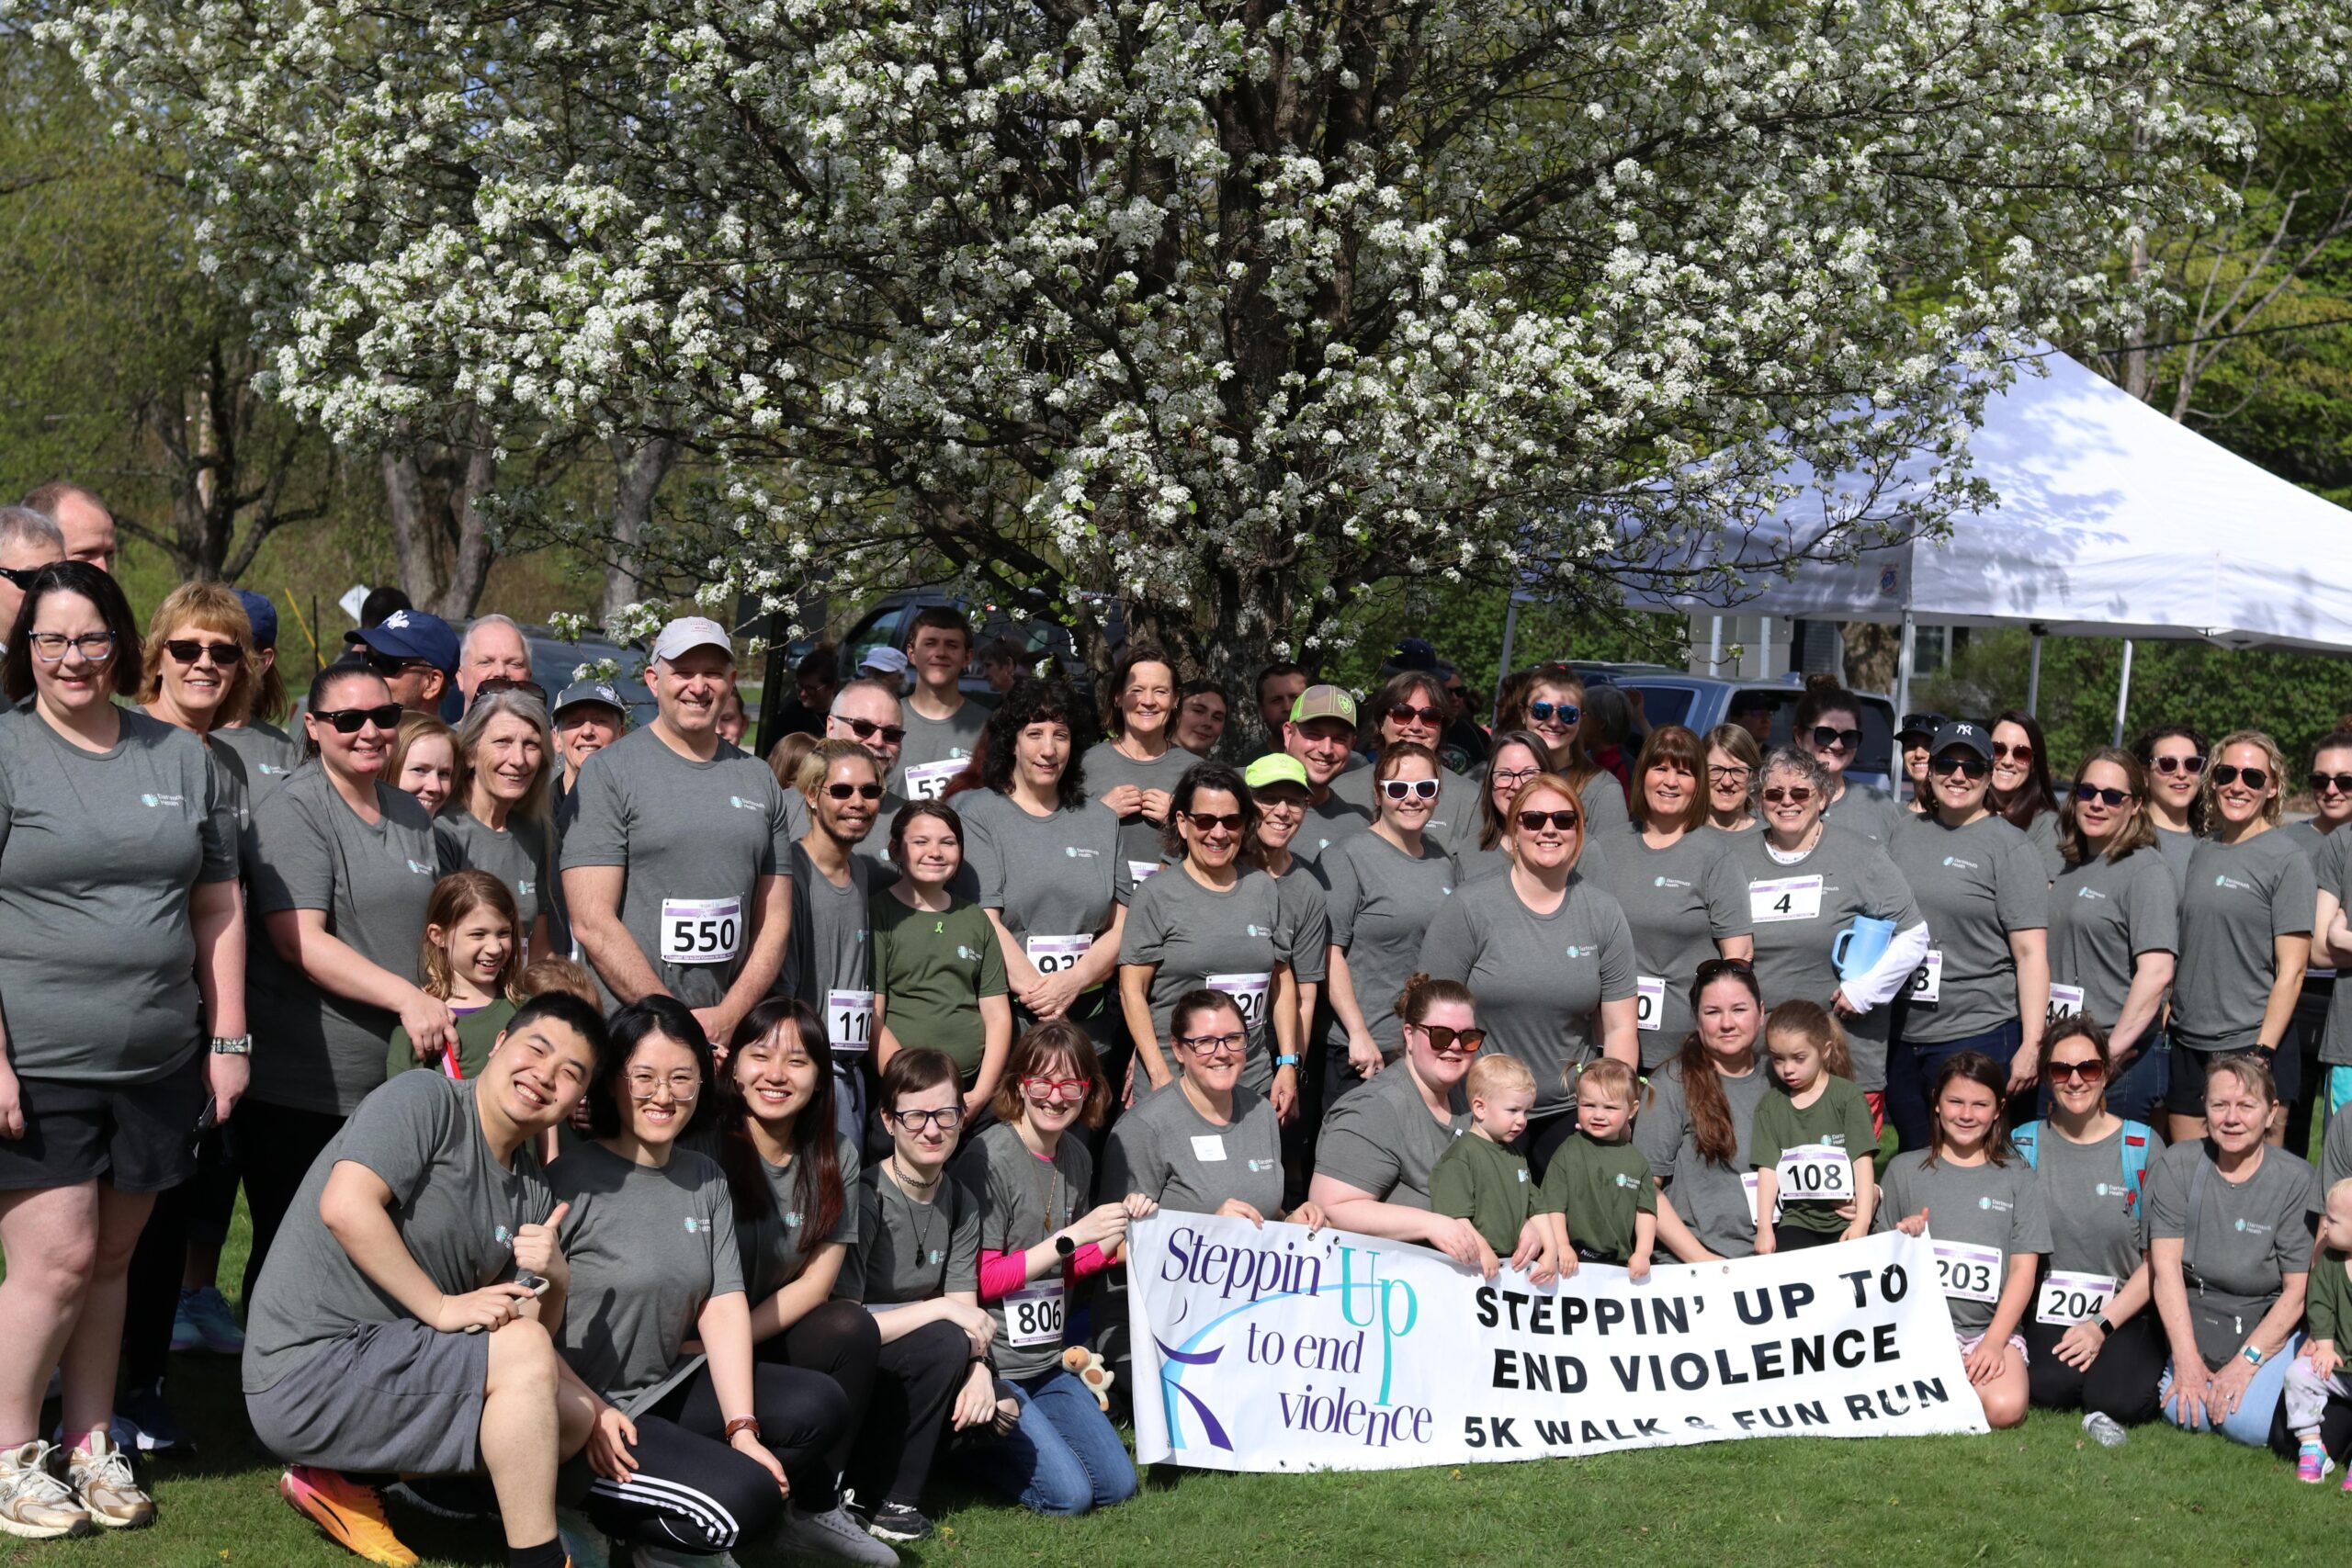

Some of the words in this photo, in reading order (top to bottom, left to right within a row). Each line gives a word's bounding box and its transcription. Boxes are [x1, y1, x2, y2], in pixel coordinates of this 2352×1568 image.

[918, 777, 950, 800] 53
[1773, 894, 1792, 913] 4
[673, 919, 735, 952] 550
[1230, 992, 1263, 1021] 20
[1638, 995, 1652, 1021] 0
[1787, 1164, 1842, 1190] 108
[1936, 1259, 1990, 1292] 203
[1476, 1286, 1705, 1336] STEPPIN'
[1733, 1282, 1815, 1325] UP
[1838, 1263, 1908, 1308] TO
[2048, 1290, 2103, 1318] 204
[1018, 1299, 1061, 1334] 806
[1161, 1227, 1331, 1303] Steppin'
[1339, 1246, 1418, 1406] Up
[1248, 1322, 1284, 1365] to
[1294, 1330, 1364, 1373] end
[1492, 1348, 1588, 1393] END
[1610, 1323, 1901, 1392] VIOLENCE
[1278, 1384, 1432, 1447] violence
[1464, 1416, 1523, 1448] 5K
[1534, 1418, 1672, 1446] WALK
[1684, 1416, 1722, 1430] &
[1732, 1400, 1830, 1430] FUN
[1844, 1377, 1950, 1421] RUN
